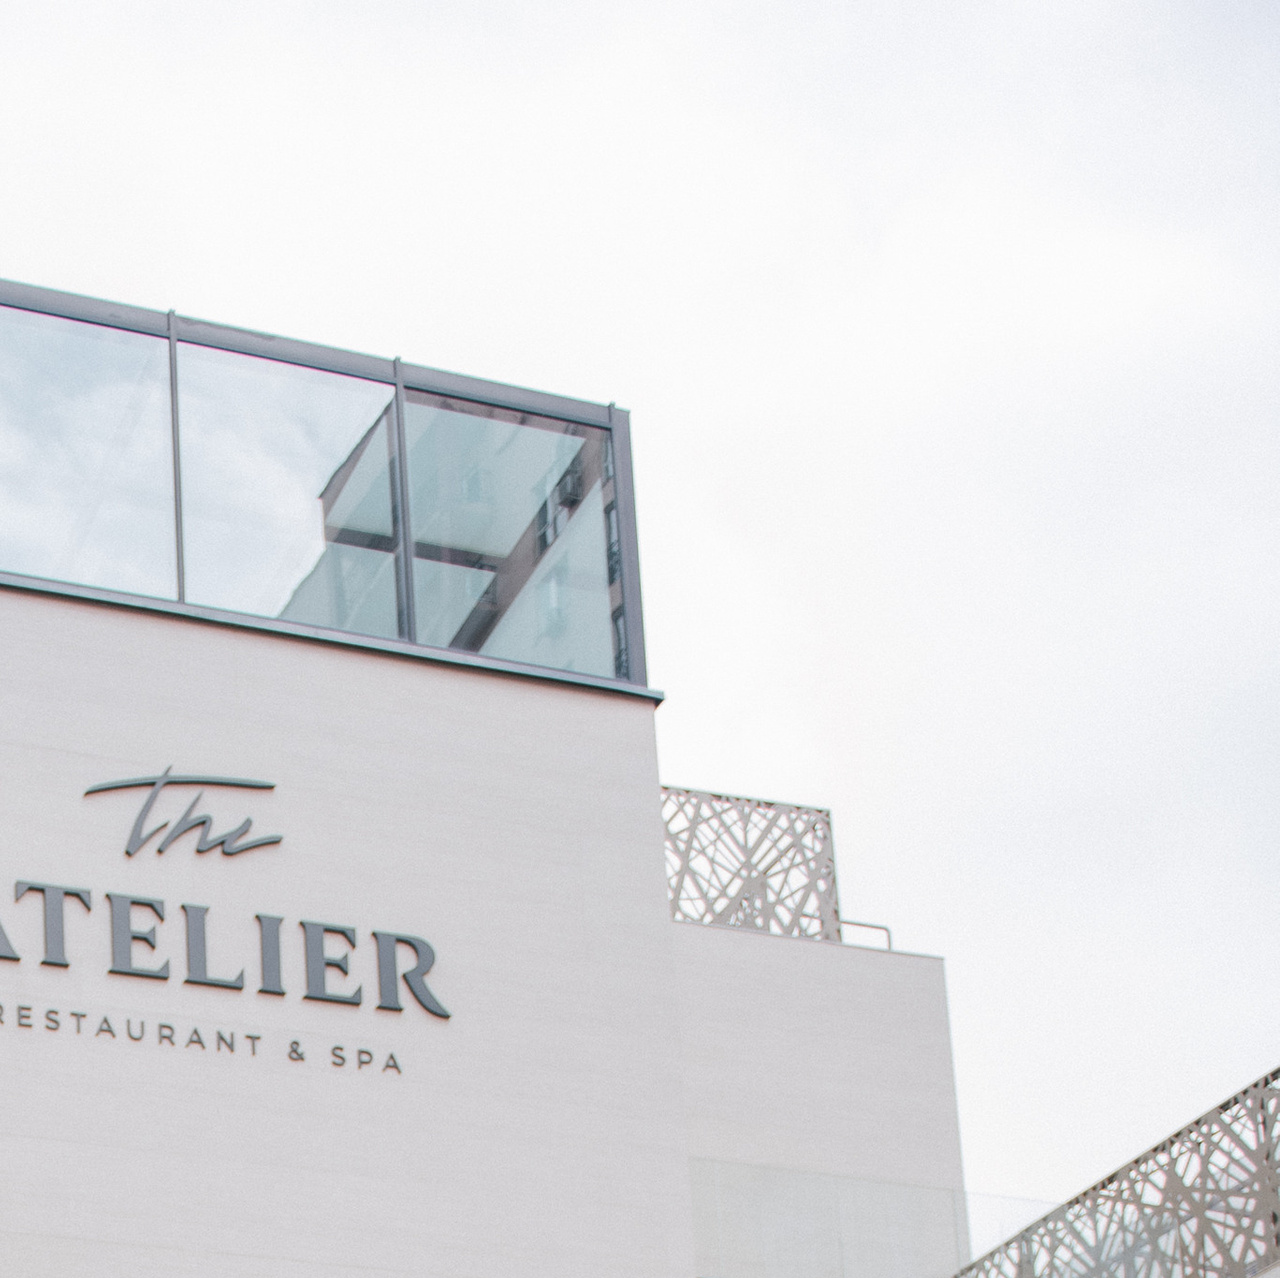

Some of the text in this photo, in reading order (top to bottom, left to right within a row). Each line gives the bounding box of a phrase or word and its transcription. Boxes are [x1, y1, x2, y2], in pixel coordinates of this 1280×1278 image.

[83, 765, 283, 858] The
[288, 1040, 306, 1062] &
[330, 1045, 403, 1074] SPA
